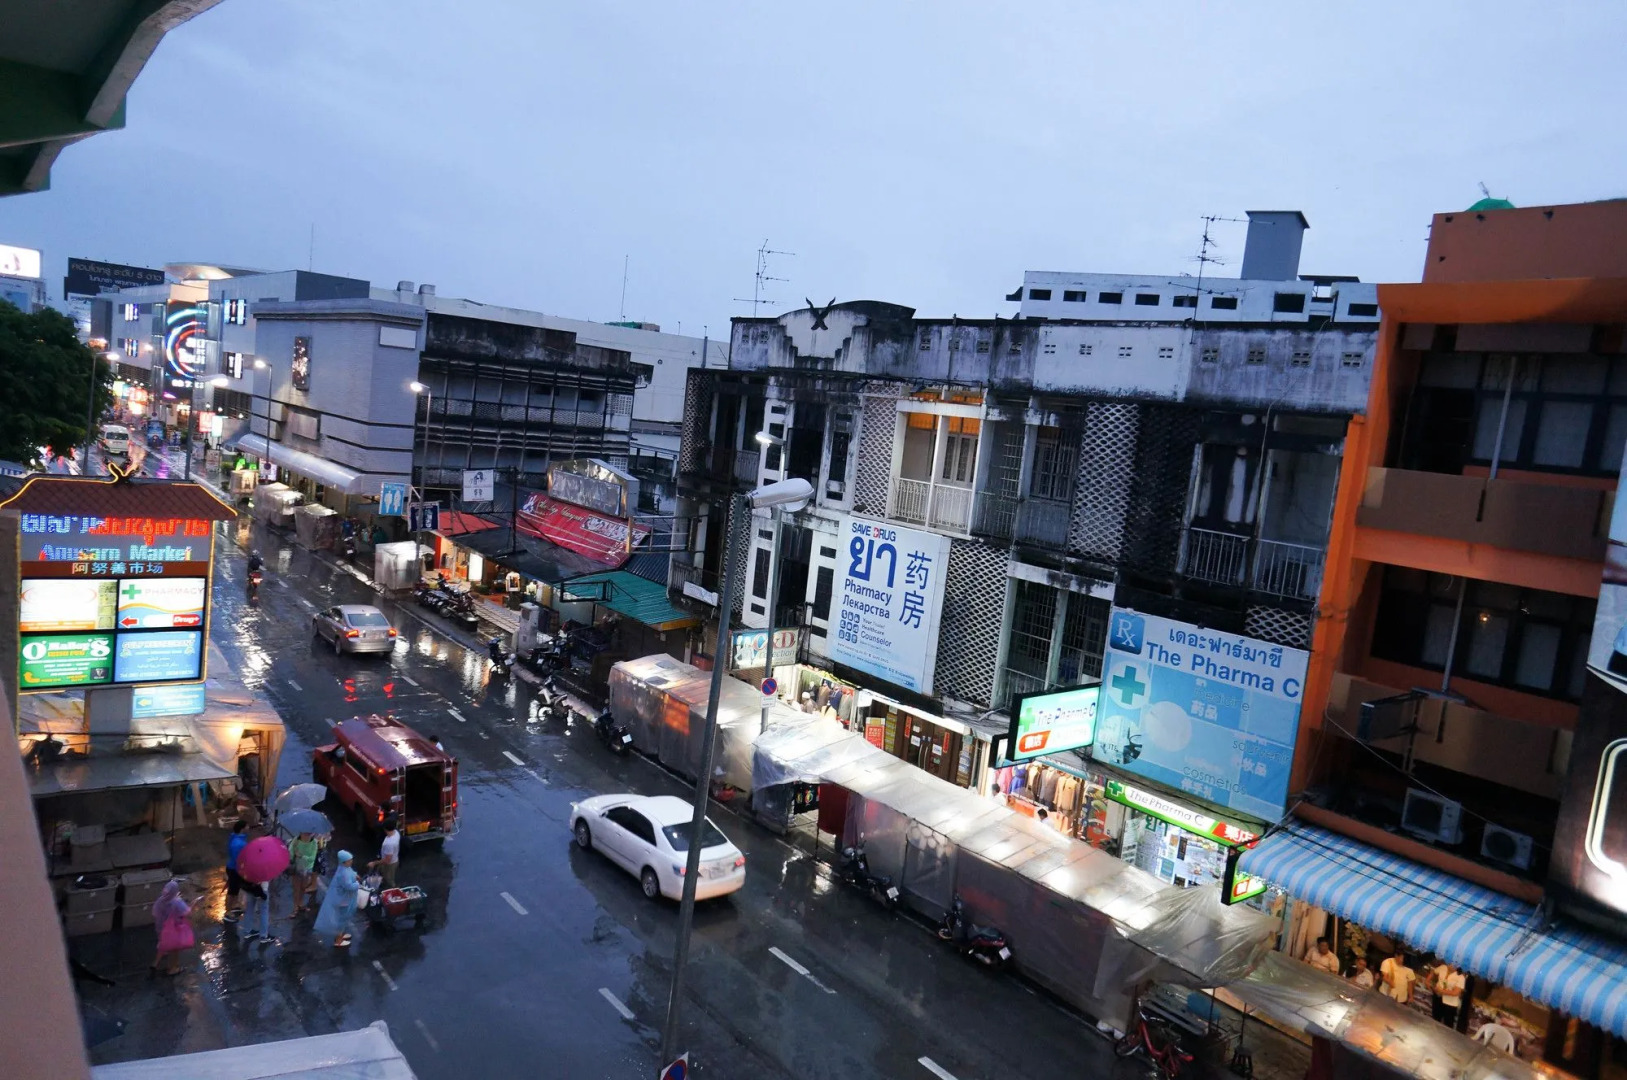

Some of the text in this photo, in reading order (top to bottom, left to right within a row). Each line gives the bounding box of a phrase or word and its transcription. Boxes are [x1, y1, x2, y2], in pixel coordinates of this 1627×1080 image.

[852, 523, 896, 542] SAVE DRUG
[39, 544, 120, 562] Anusarn
[848, 535, 898, 588] ยา
[72, 562, 164, 575] 阿努善市场
[145, 587, 205, 595] PHARMACY
[844, 578, 893, 607] Pharmacy
[899, 550, 932, 629] 药房
[842, 595, 891, 619] Лекарства
[860, 630, 892, 648] Counselor
[1169, 628, 1284, 669] เดอะฟาร์มาซี
[1146, 642, 1300, 698] The Pharma C
[1037, 710, 1053, 727] The
[1183, 765, 1247, 794] cosmetics
[1129, 789, 1205, 827] The Pharma C
